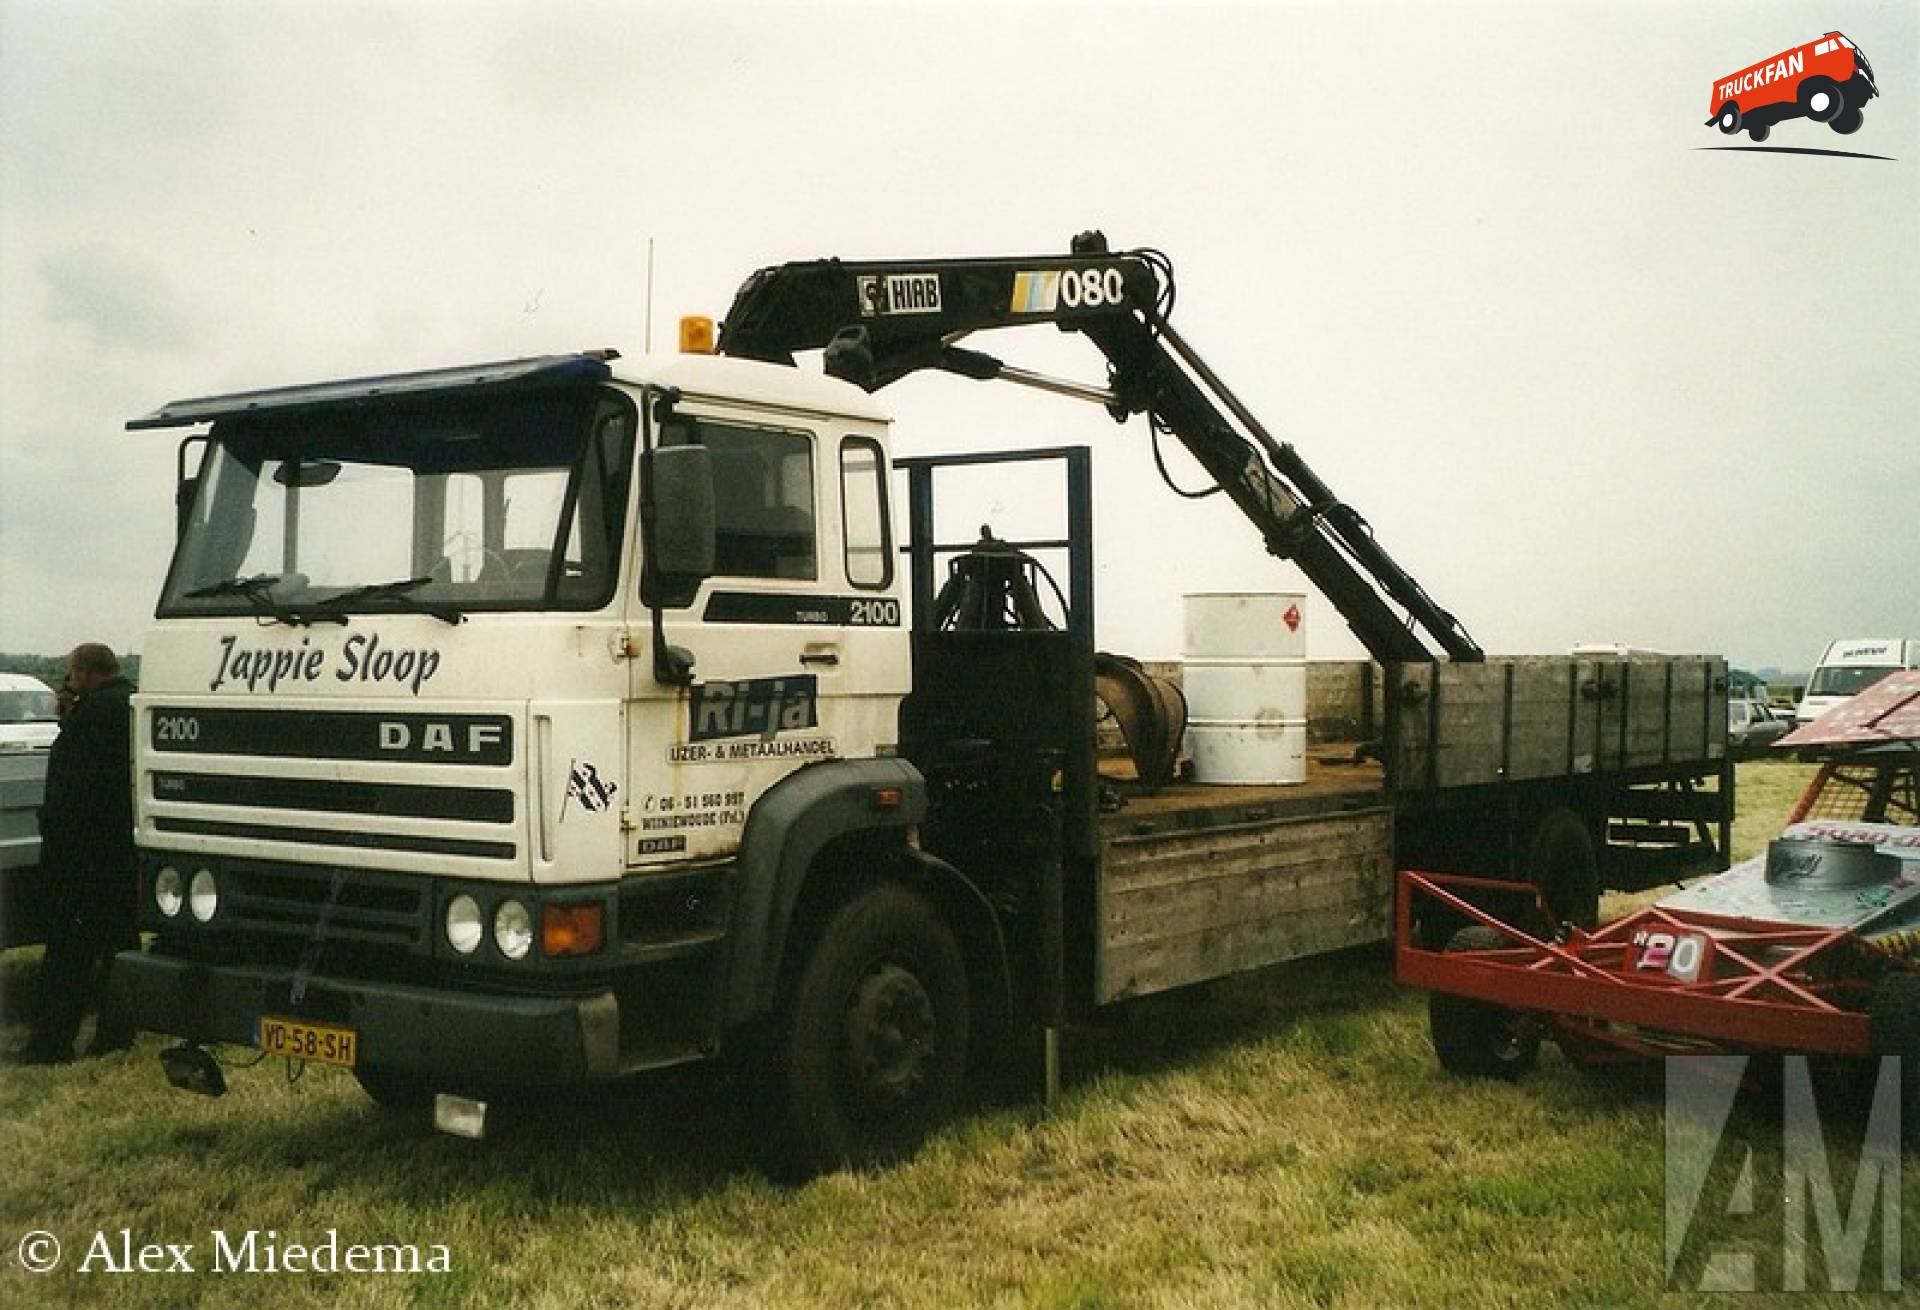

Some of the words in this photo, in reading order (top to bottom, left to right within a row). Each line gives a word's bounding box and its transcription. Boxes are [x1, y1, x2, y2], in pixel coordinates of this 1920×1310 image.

[892, 278, 938, 311] HIAB
[1062, 268, 1124, 307] 080
[851, 601, 896, 625] 2100
[210, 634, 325, 693] Jappie
[335, 633, 441, 696] Sloop
[157, 716, 200, 741] 2100
[378, 721, 503, 752] DAF
[715, 745, 726, 760] &
[729, 739, 835, 760] METAALHANDEL
